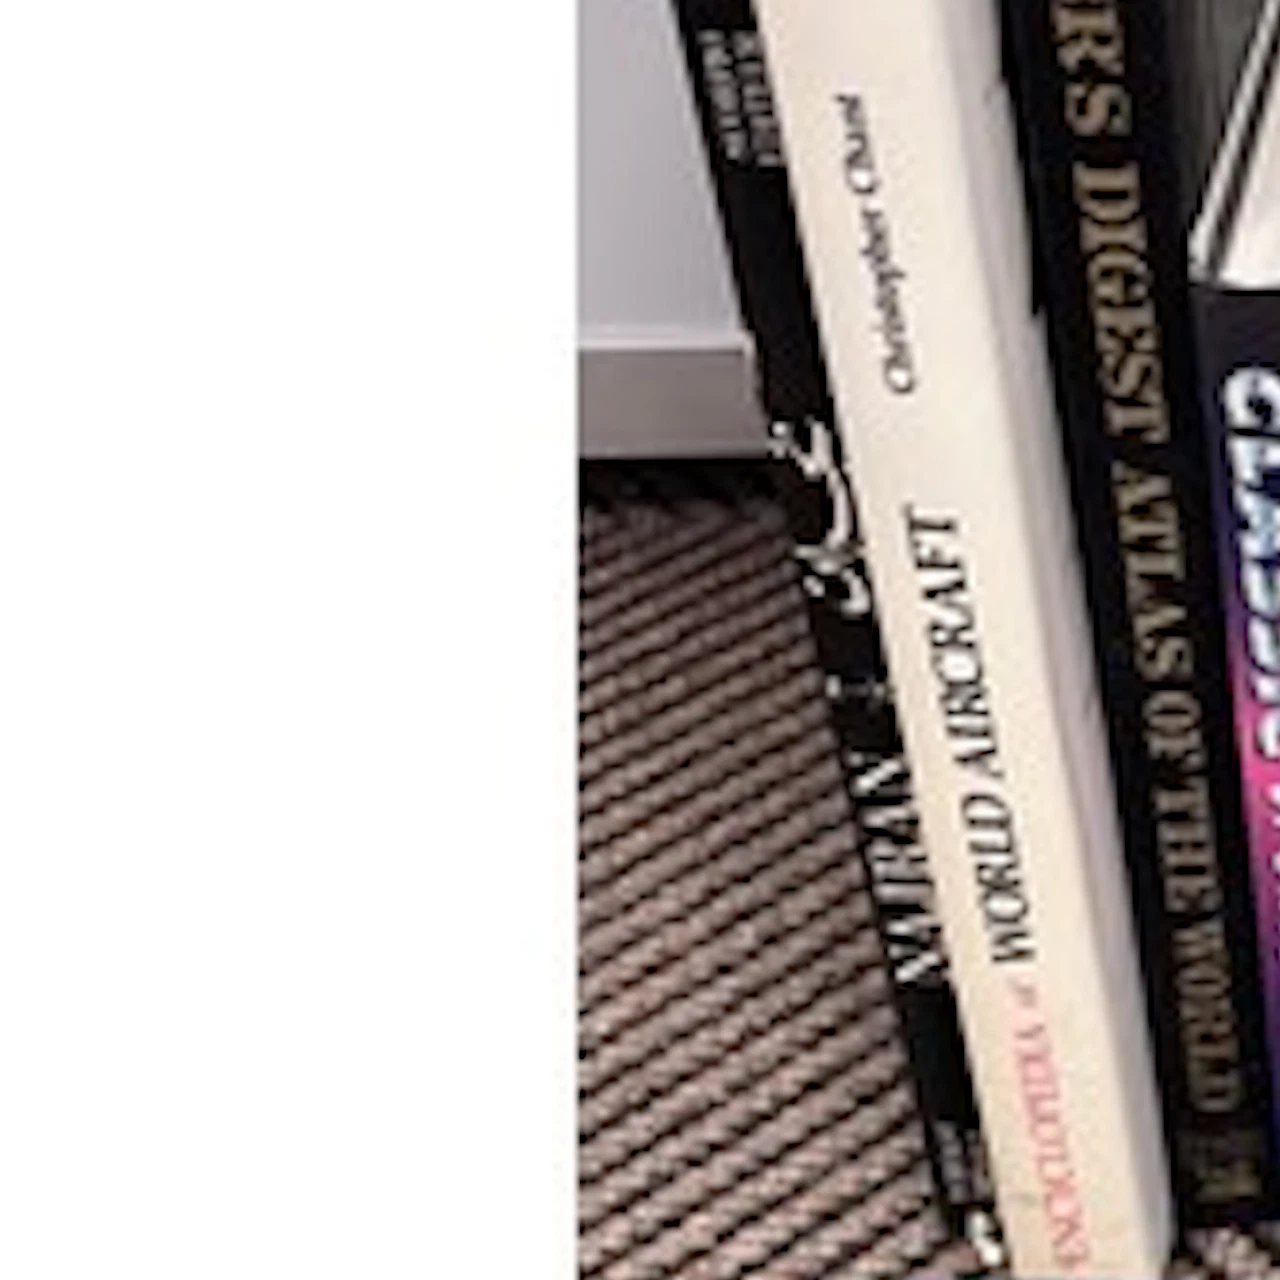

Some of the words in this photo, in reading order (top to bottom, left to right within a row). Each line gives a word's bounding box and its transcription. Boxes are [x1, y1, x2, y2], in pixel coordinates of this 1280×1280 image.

[858, 205, 917, 397] Christopher
[1072, 158, 1172, 445] DIGEST
[903, 500, 1004, 778] AIRCRAFT
[1110, 458, 1196, 682] ATLAS
[1142, 688, 1208, 772] OF
[960, 792, 1036, 964] WORLD
[1155, 776, 1224, 916] THE
[1172, 916, 1243, 1114] WORLD
